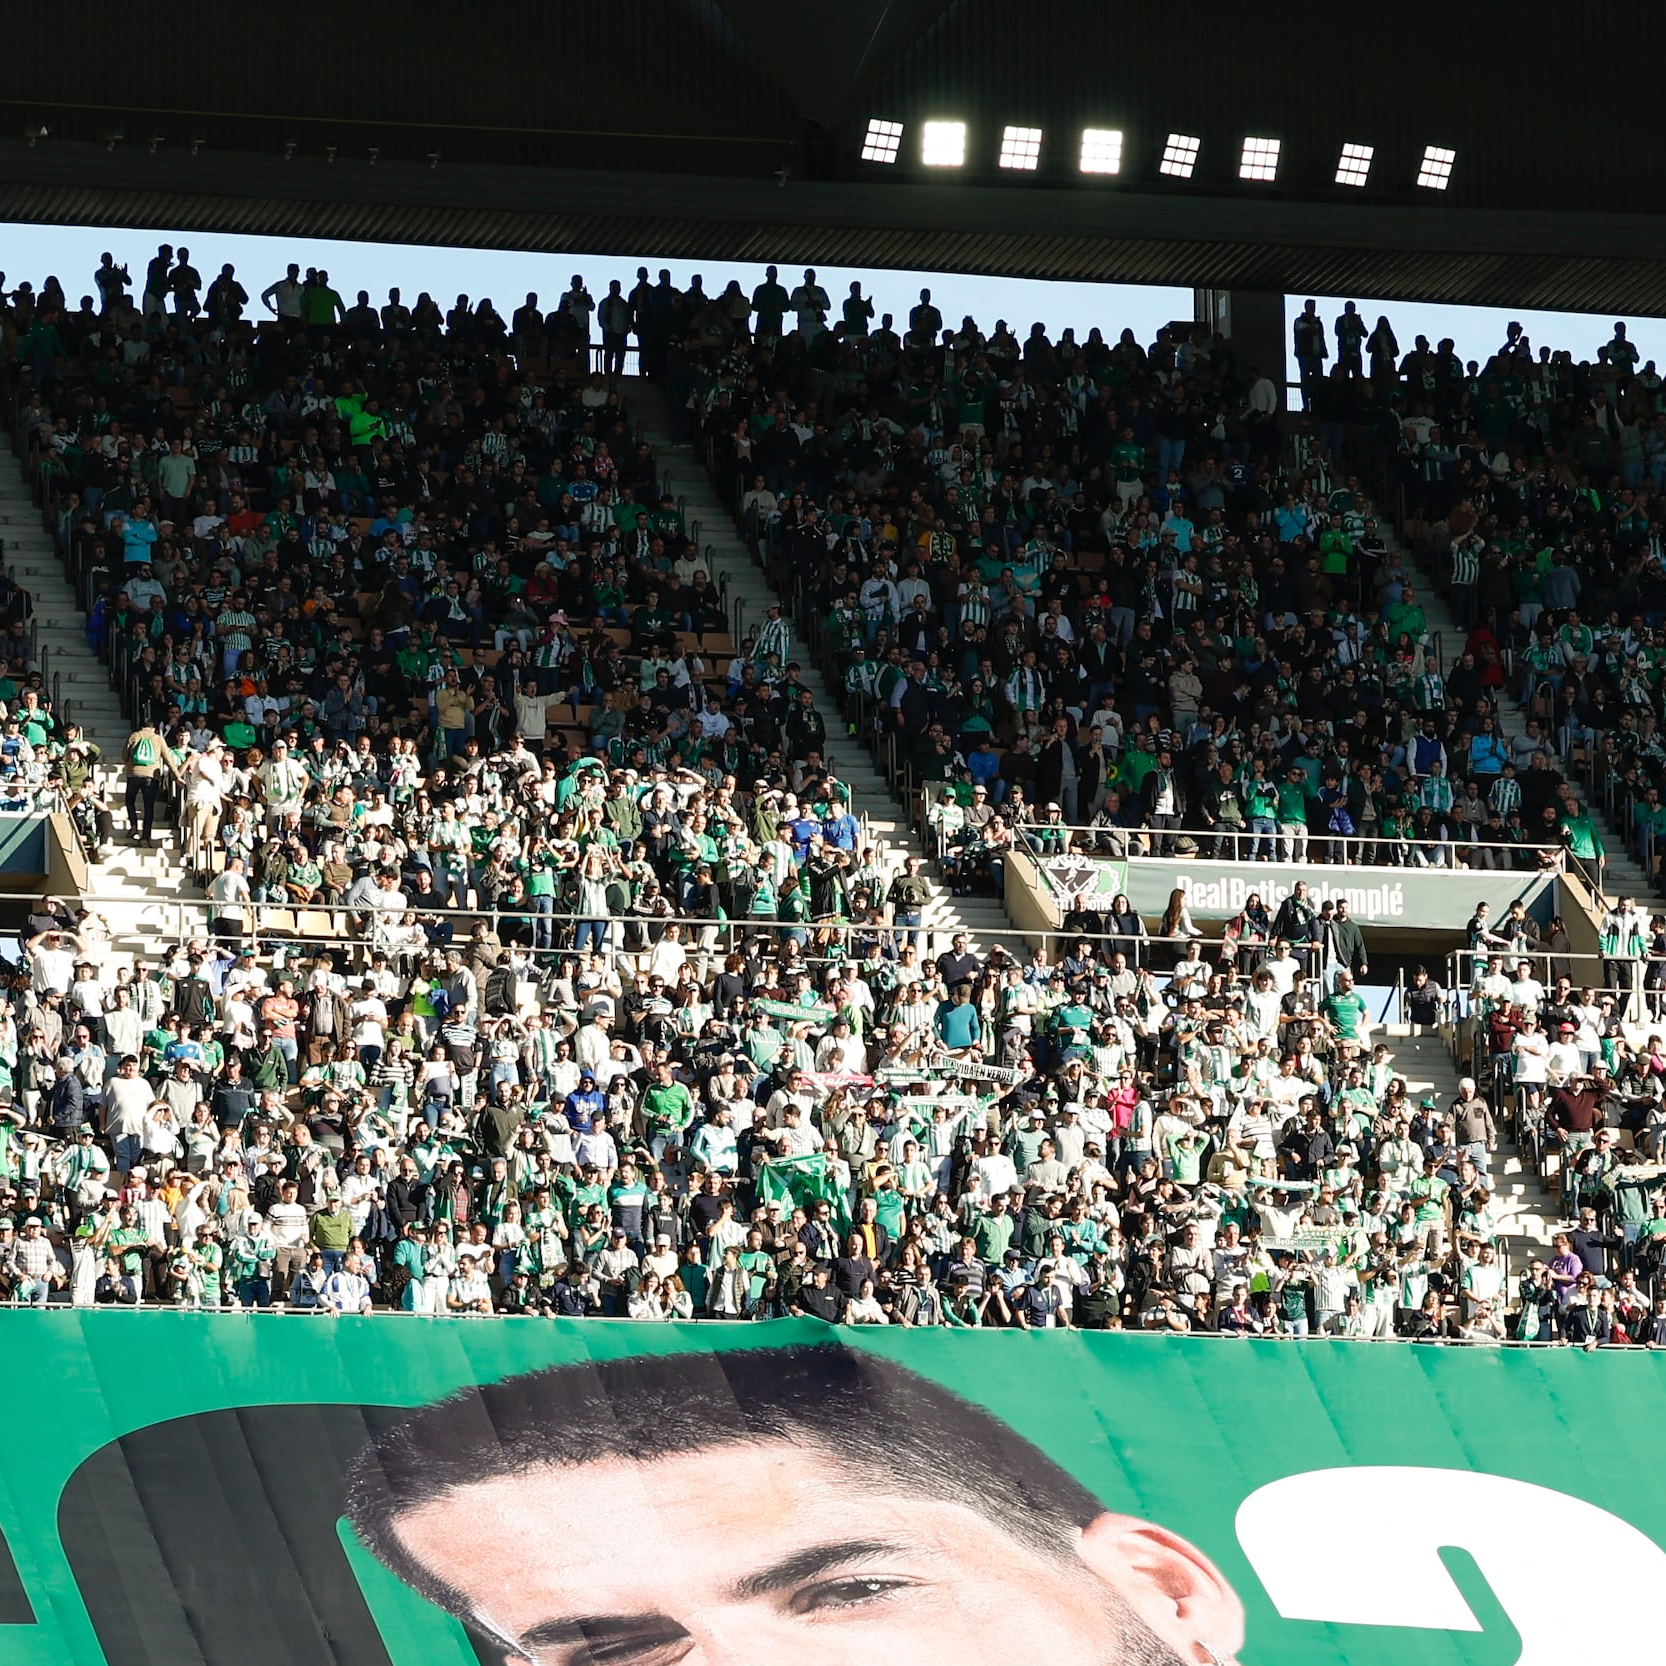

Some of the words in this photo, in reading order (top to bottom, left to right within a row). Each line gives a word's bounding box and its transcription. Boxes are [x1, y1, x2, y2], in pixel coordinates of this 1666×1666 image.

[1176, 875, 1228, 909] Real
[1293, 880, 1404, 917] alompié
[955, 1060, 976, 1077] VIDA
